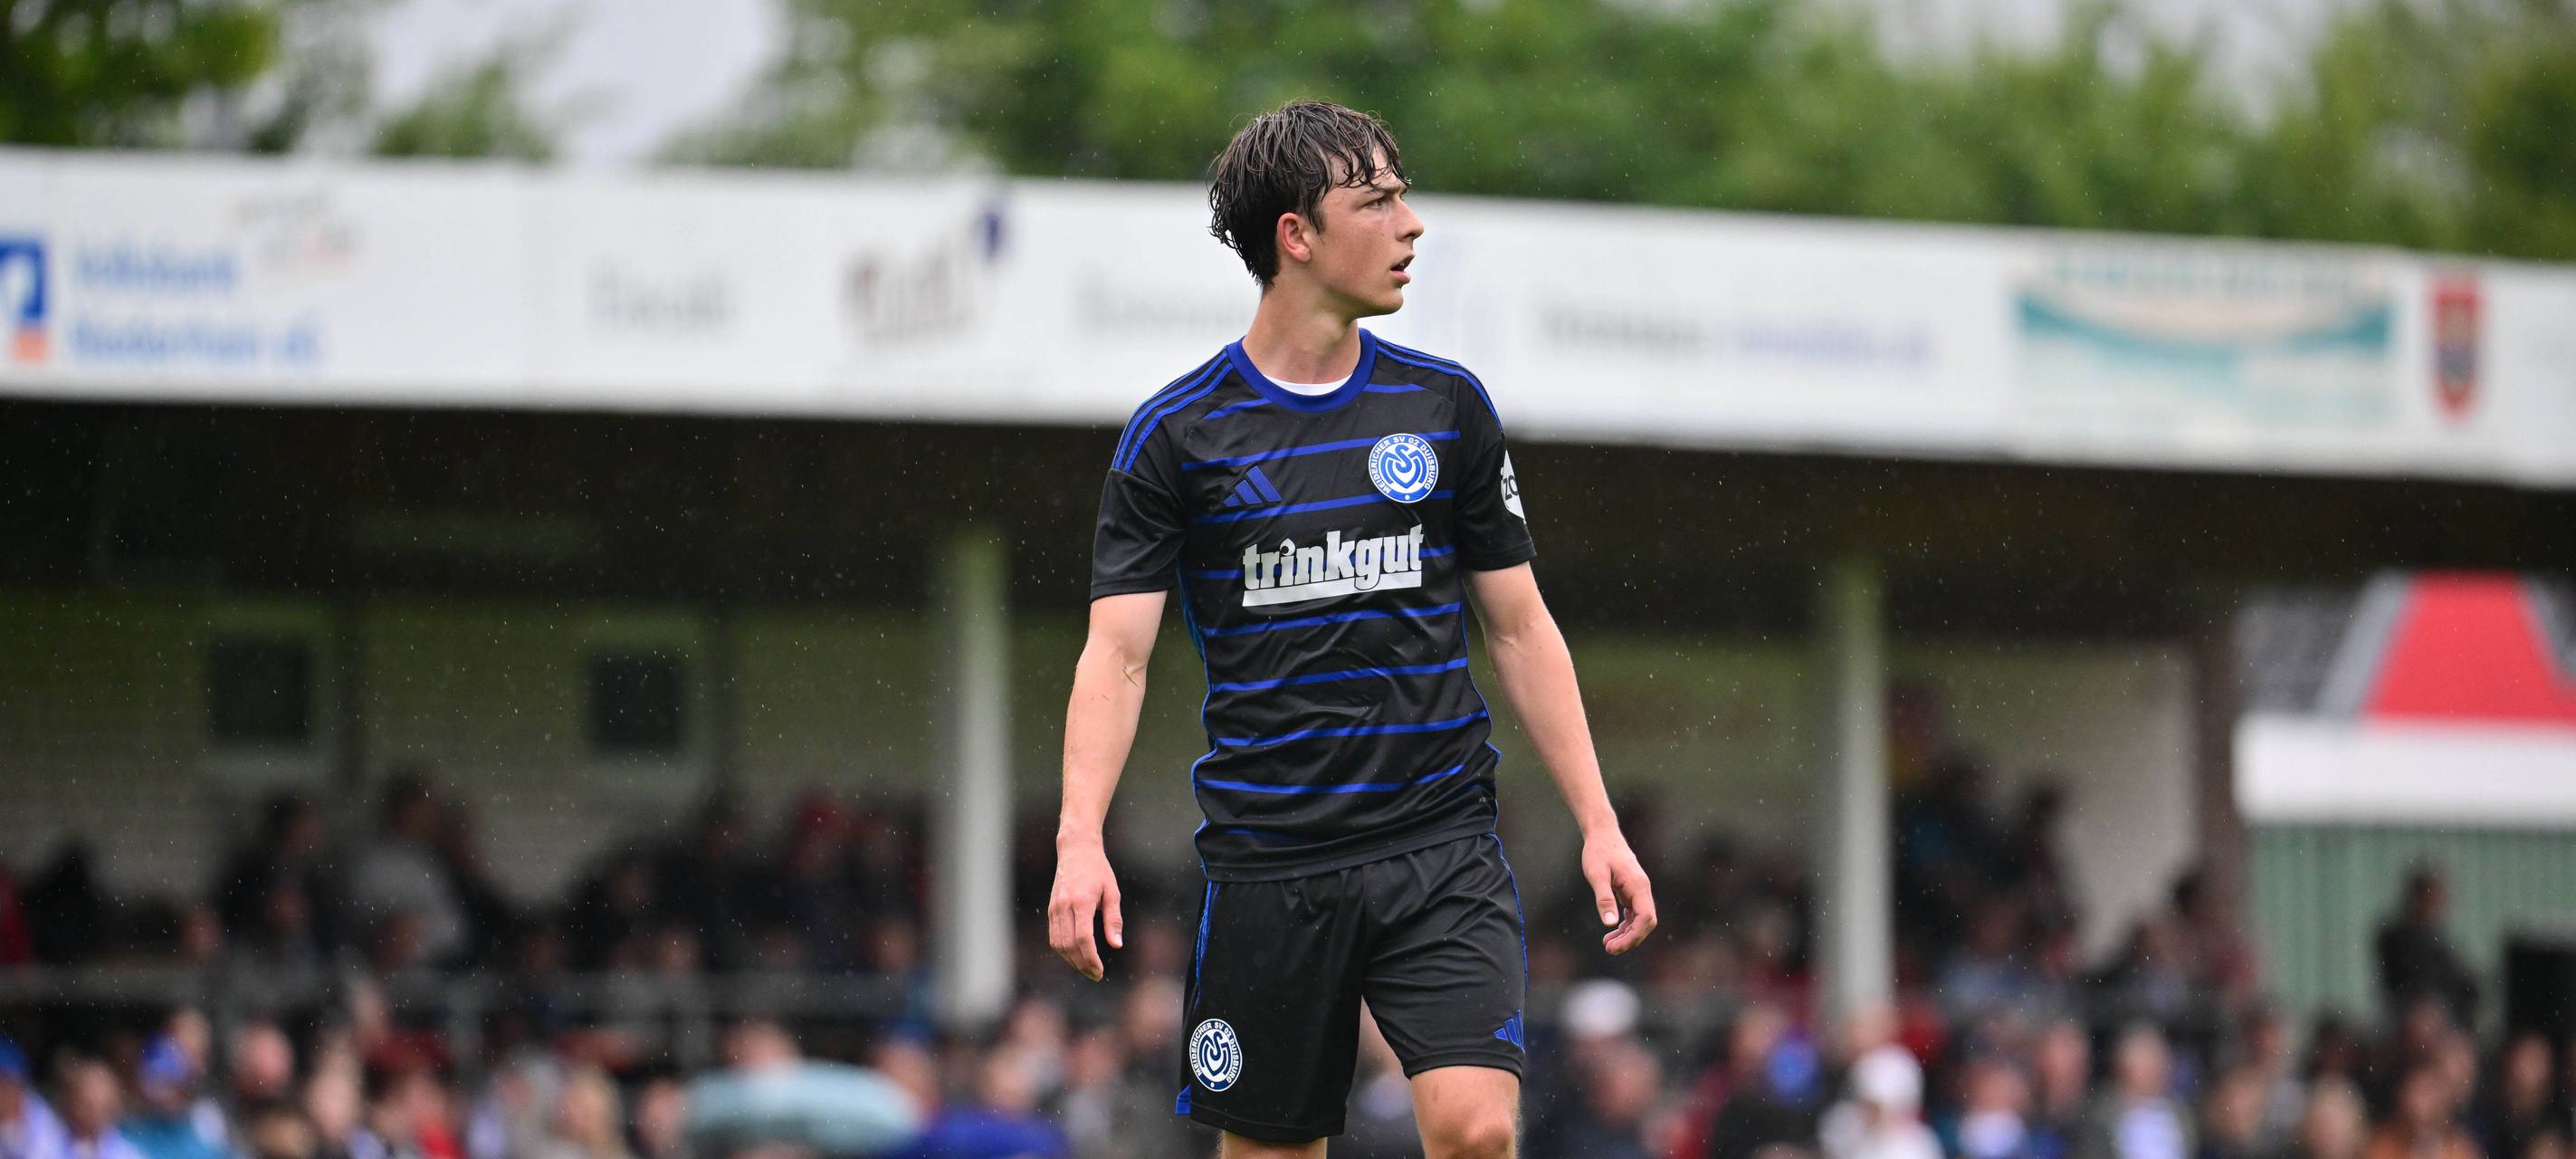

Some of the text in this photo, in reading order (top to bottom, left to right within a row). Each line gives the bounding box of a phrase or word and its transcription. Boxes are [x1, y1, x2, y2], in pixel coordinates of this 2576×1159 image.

[1371, 436, 1435, 494] MEIDERICHER SV 02 DUISBURG
[1243, 524, 1424, 590] trinkgut
[1191, 1021, 1239, 1084] MEIDERICHER SV 02 DUISBURG
